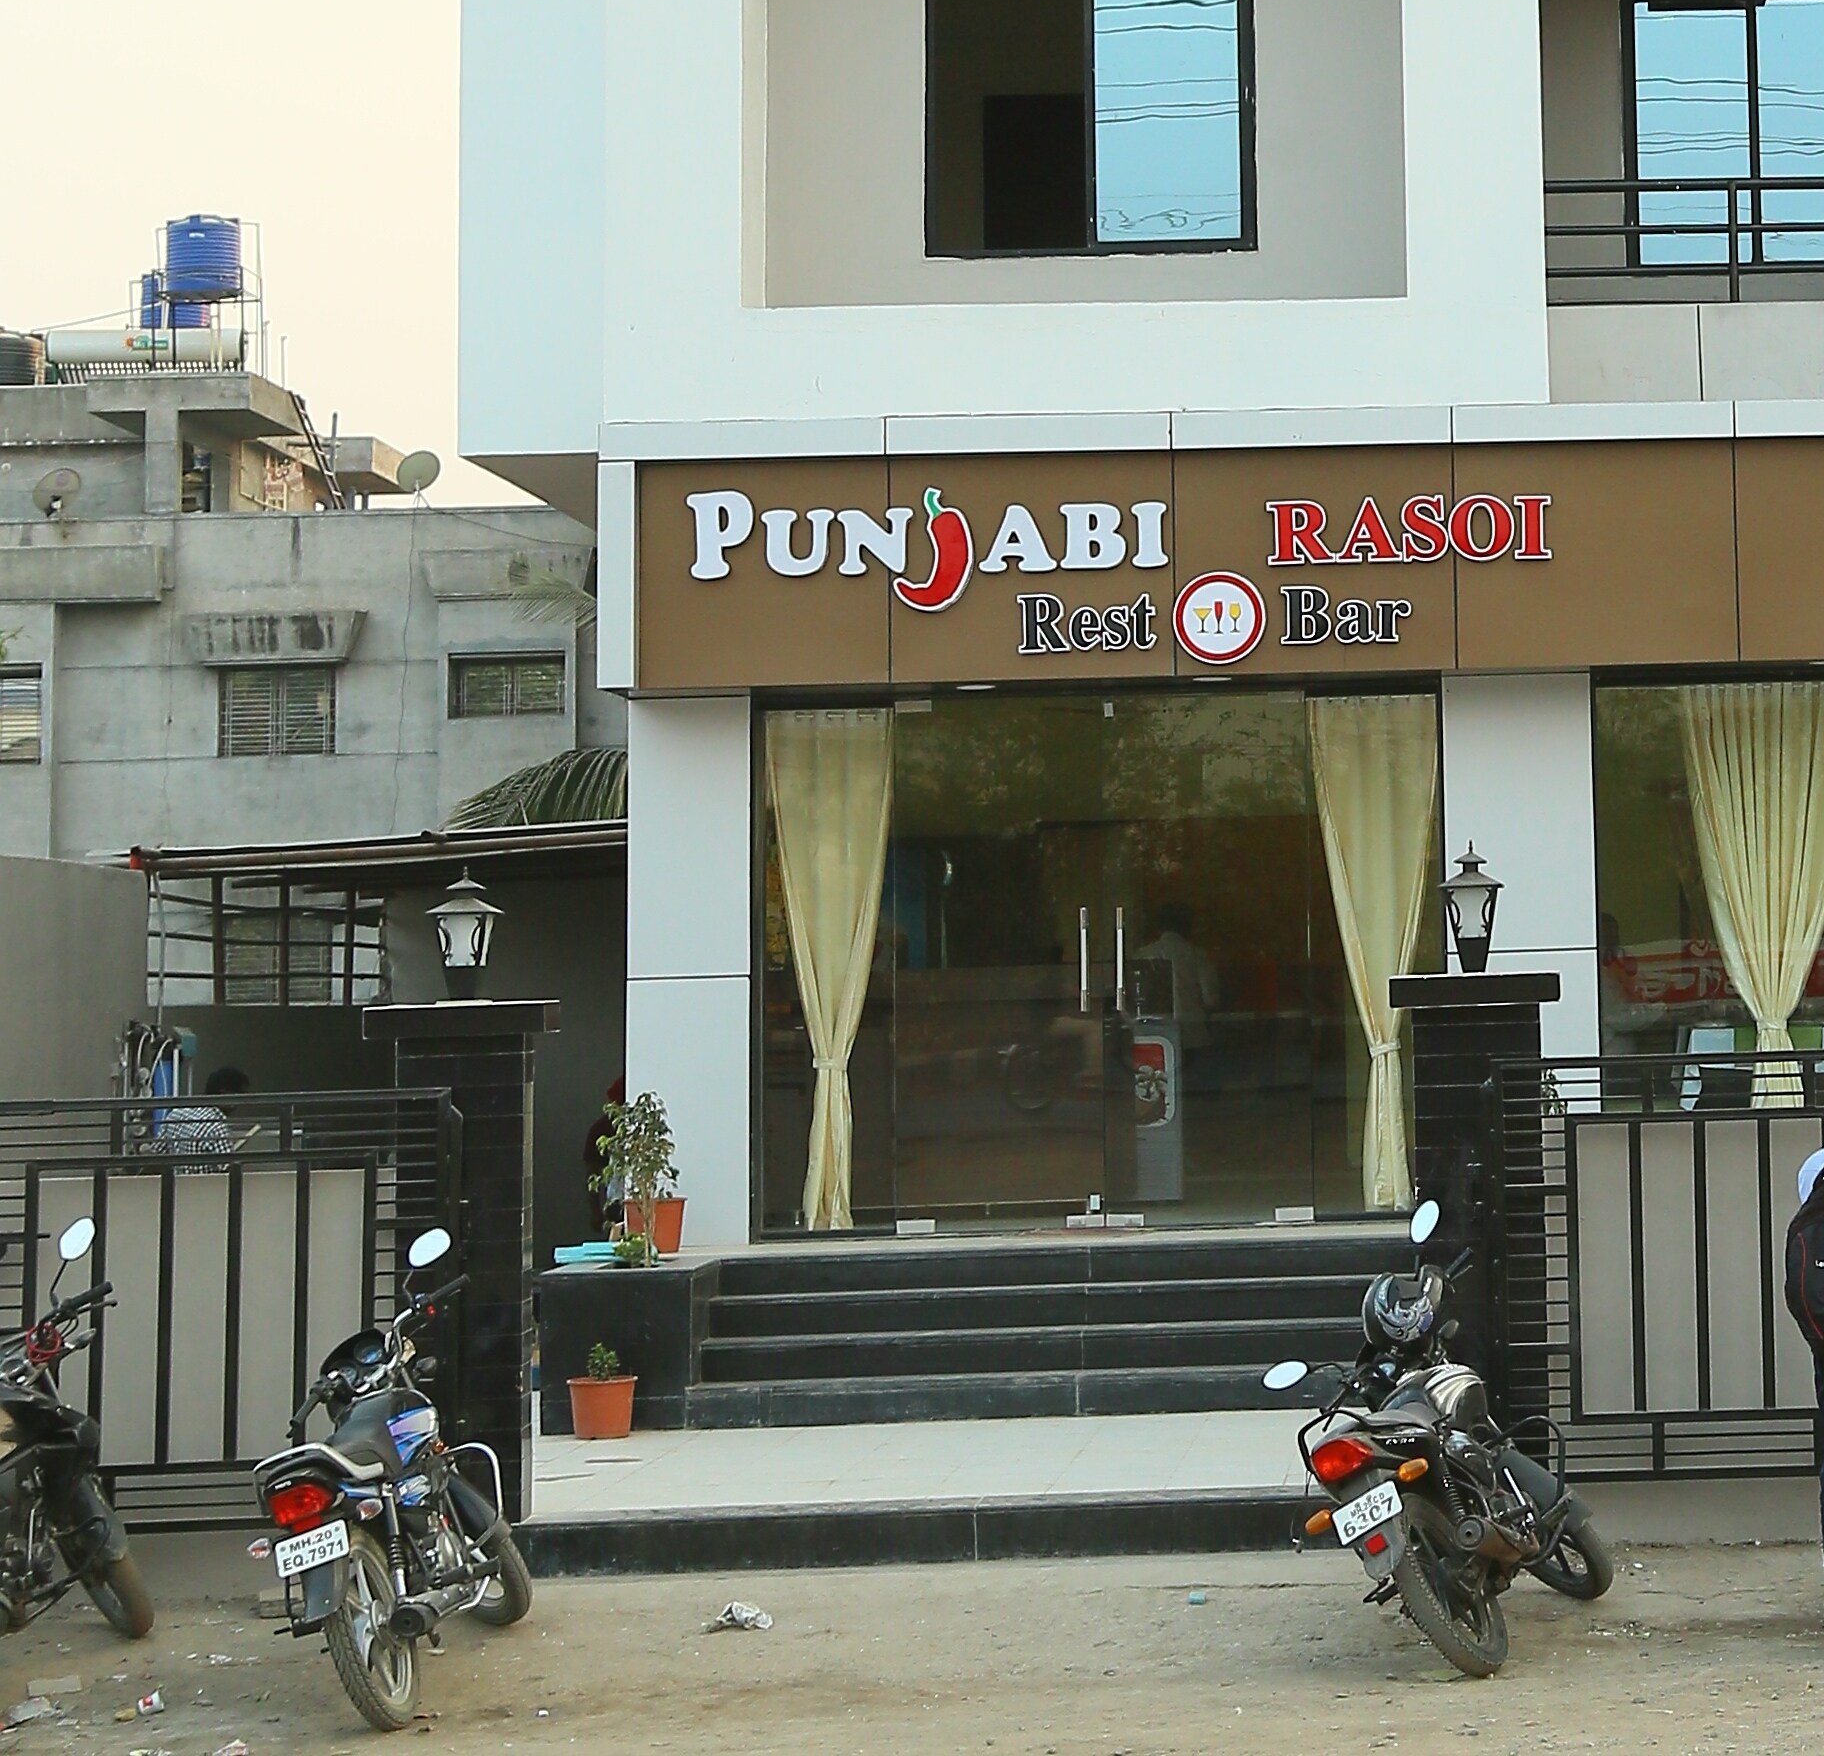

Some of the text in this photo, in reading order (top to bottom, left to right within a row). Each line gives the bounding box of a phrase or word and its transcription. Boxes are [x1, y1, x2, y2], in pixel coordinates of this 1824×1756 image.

[1265, 494, 1553, 567] RASOI
[1017, 585, 1412, 656] Rest Bar
[289, 1529, 332, 1553] MH.20
